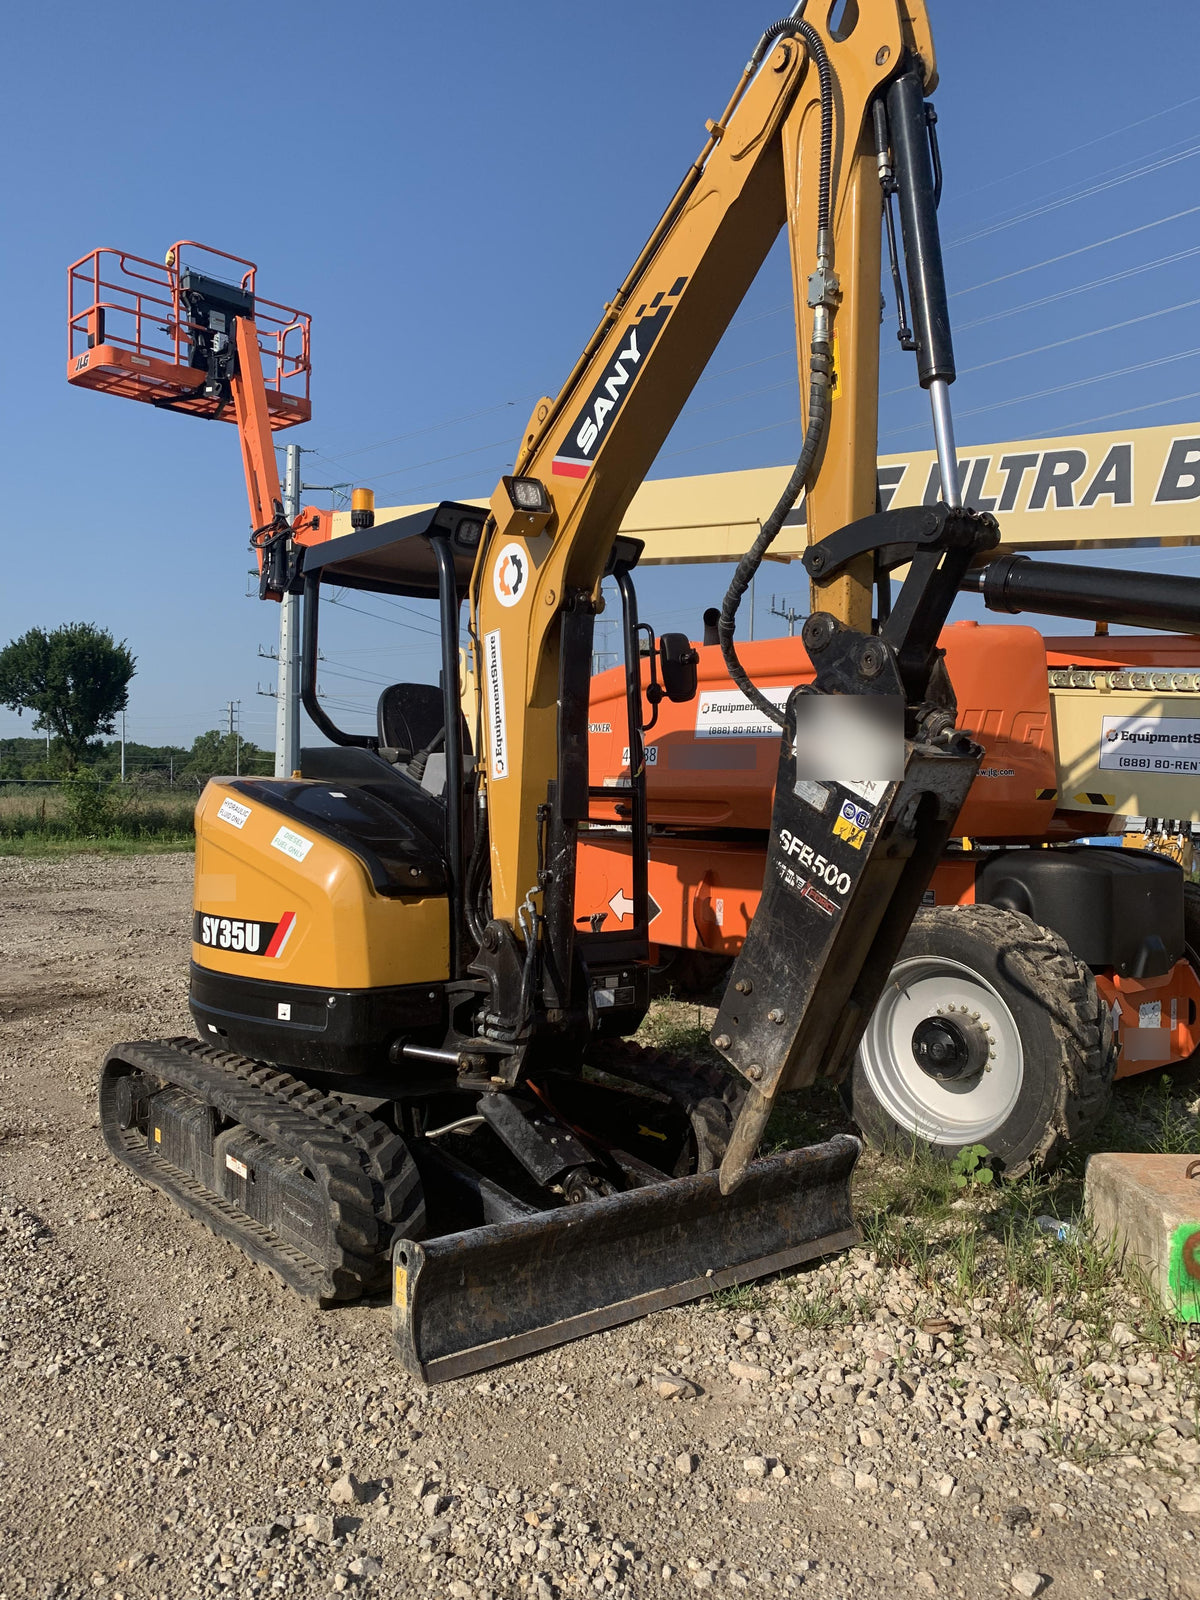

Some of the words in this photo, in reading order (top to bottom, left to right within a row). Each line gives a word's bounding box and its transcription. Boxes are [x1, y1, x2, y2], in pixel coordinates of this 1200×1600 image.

[75, 353, 90, 372] JLG
[576, 327, 641, 456] SANY
[923, 442, 1134, 513] ULTRA
[488, 635, 502, 757] EquipmentShare
[1119, 757, 1150, 769] (888)
[219, 808, 231, 820] FLUID
[231, 814, 245, 825] ONLY
[224, 800, 249, 817] HYDRAULIC
[274, 837, 288, 850] FUEL
[288, 845, 305, 858] ONLY
[284, 832, 304, 847] DIESEL
[779, 828, 852, 895] SFB500
[202, 916, 261, 952] SY35U
